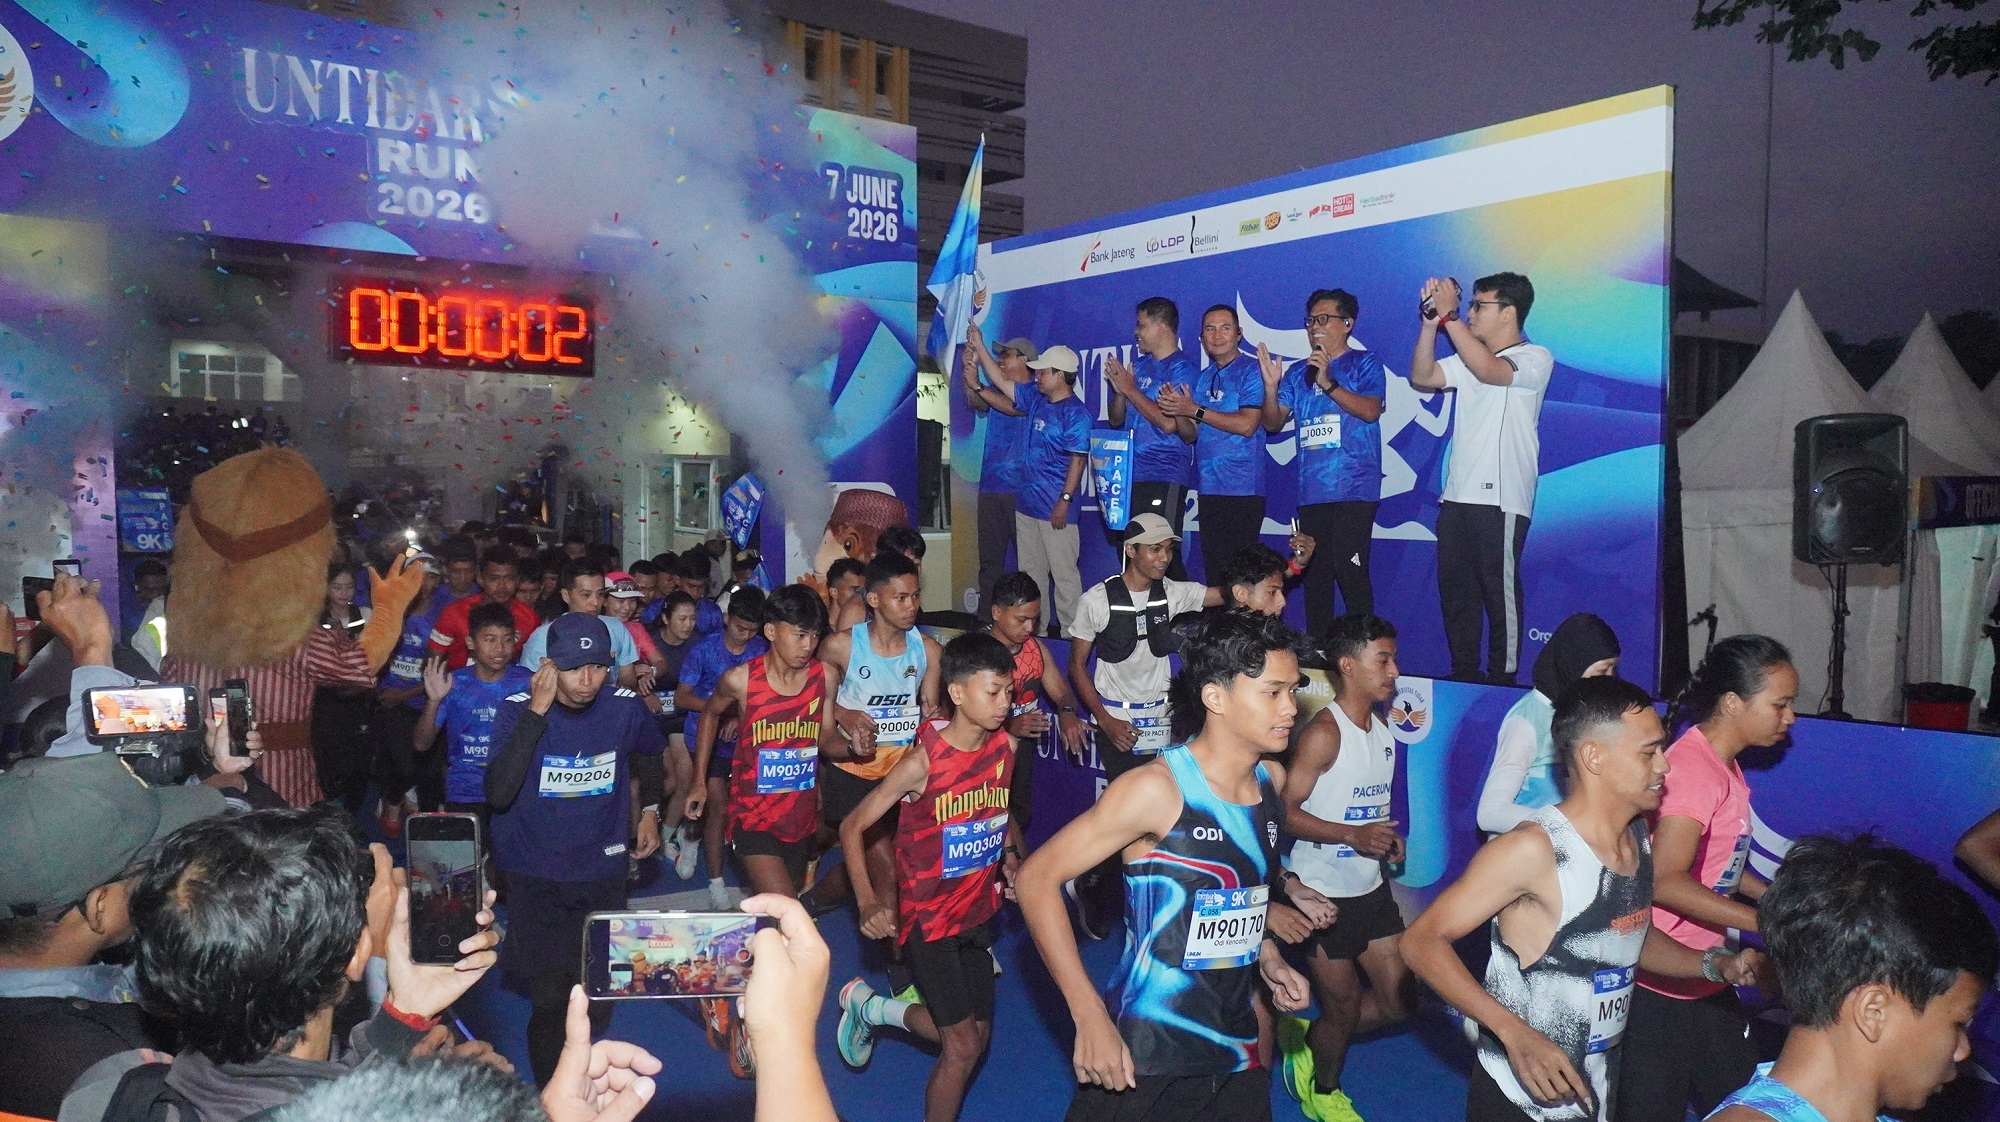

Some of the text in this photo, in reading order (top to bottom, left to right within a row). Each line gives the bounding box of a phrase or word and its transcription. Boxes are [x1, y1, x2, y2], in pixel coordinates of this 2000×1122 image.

[826, 168, 898, 209] 7 JUNE
[377, 182, 491, 225] 2026
[847, 207, 898, 243] 2026
[1160, 235, 1185, 248] LDP
[1194, 231, 1219, 246] Bellini
[1090, 251, 1110, 263] Bank
[1110, 247, 1135, 262] Jateng
[350, 287, 588, 365] 00:00:02
[1109, 455, 1123, 524] PACER
[137, 533, 163, 549] 9K
[887, 708, 899, 717] 9K
[1013, 707, 1023, 717] 9K
[784, 749, 797, 760] 9K
[573, 758, 590, 768] 9K
[763, 761, 814, 778] M90374
[547, 768, 611, 783] M90206
[1353, 782, 1391, 799] PACERUN
[1366, 807, 1378, 818] 9K
[972, 821, 987, 834] 9K
[1192, 826, 1224, 842] ODI
[948, 831, 1003, 859] M90308
[1231, 890, 1248, 907] 9K
[1200, 908, 1206, 916] C
[1196, 913, 1264, 940] M90170
